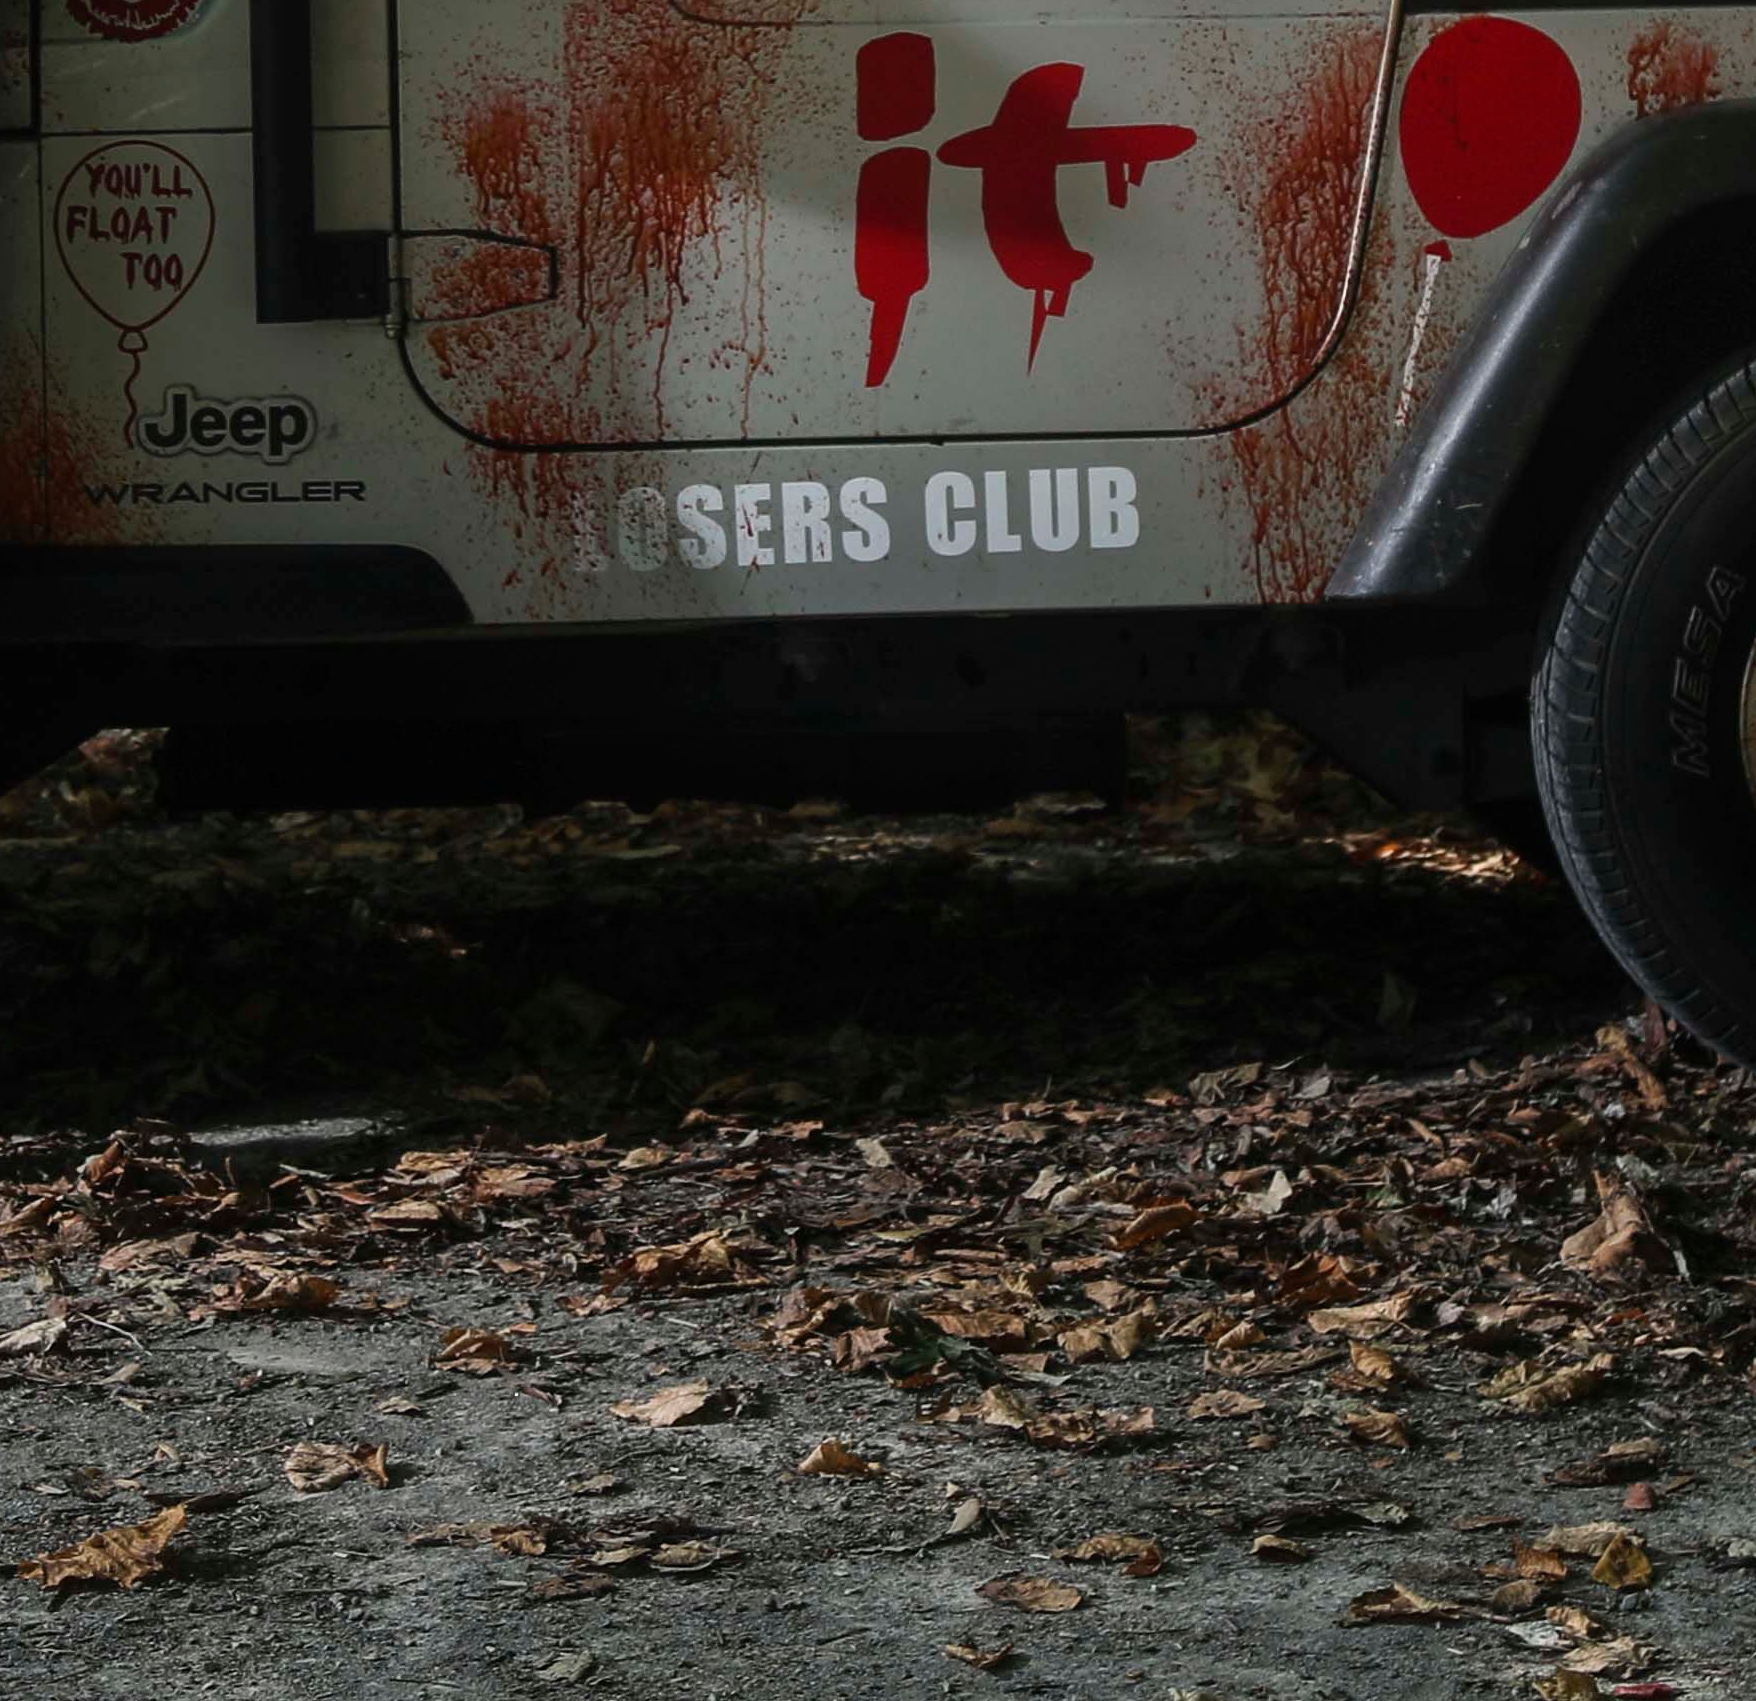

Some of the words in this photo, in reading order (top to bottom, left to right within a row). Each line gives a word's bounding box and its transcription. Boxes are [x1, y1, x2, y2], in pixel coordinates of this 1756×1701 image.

[84, 163, 192, 200] YOU'LL
[65, 205, 177, 244] FLOAT
[854, 32, 1197, 388] it
[123, 252, 183, 289] TOO
[142, 391, 310, 458] Jeep
[84, 481, 366, 503] WRANGLER
[924, 465, 1140, 556] CLUB
[1672, 564, 1746, 777] MESA
